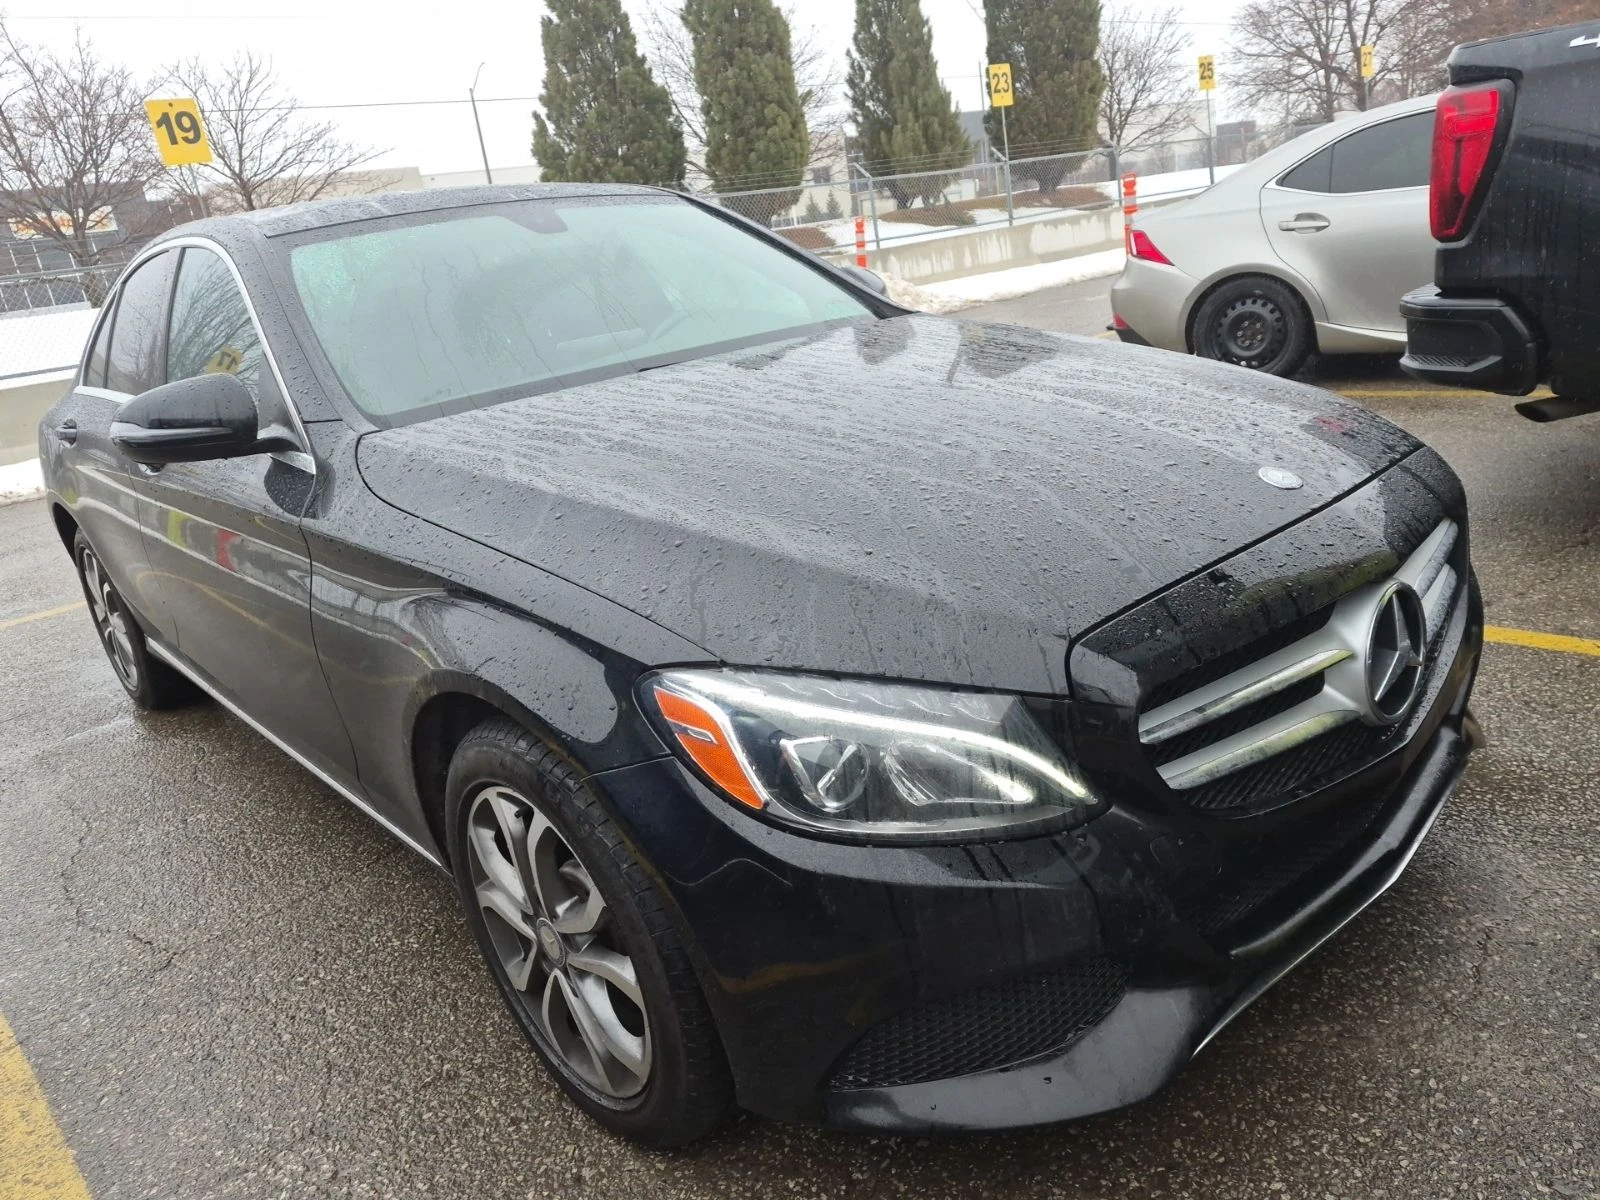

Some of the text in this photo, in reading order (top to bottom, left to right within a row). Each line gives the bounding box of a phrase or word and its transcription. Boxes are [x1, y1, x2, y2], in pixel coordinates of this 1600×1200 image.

[1200, 61, 1214, 80] 25
[992, 72, 1010, 94] 23
[156, 111, 201, 145] 19
